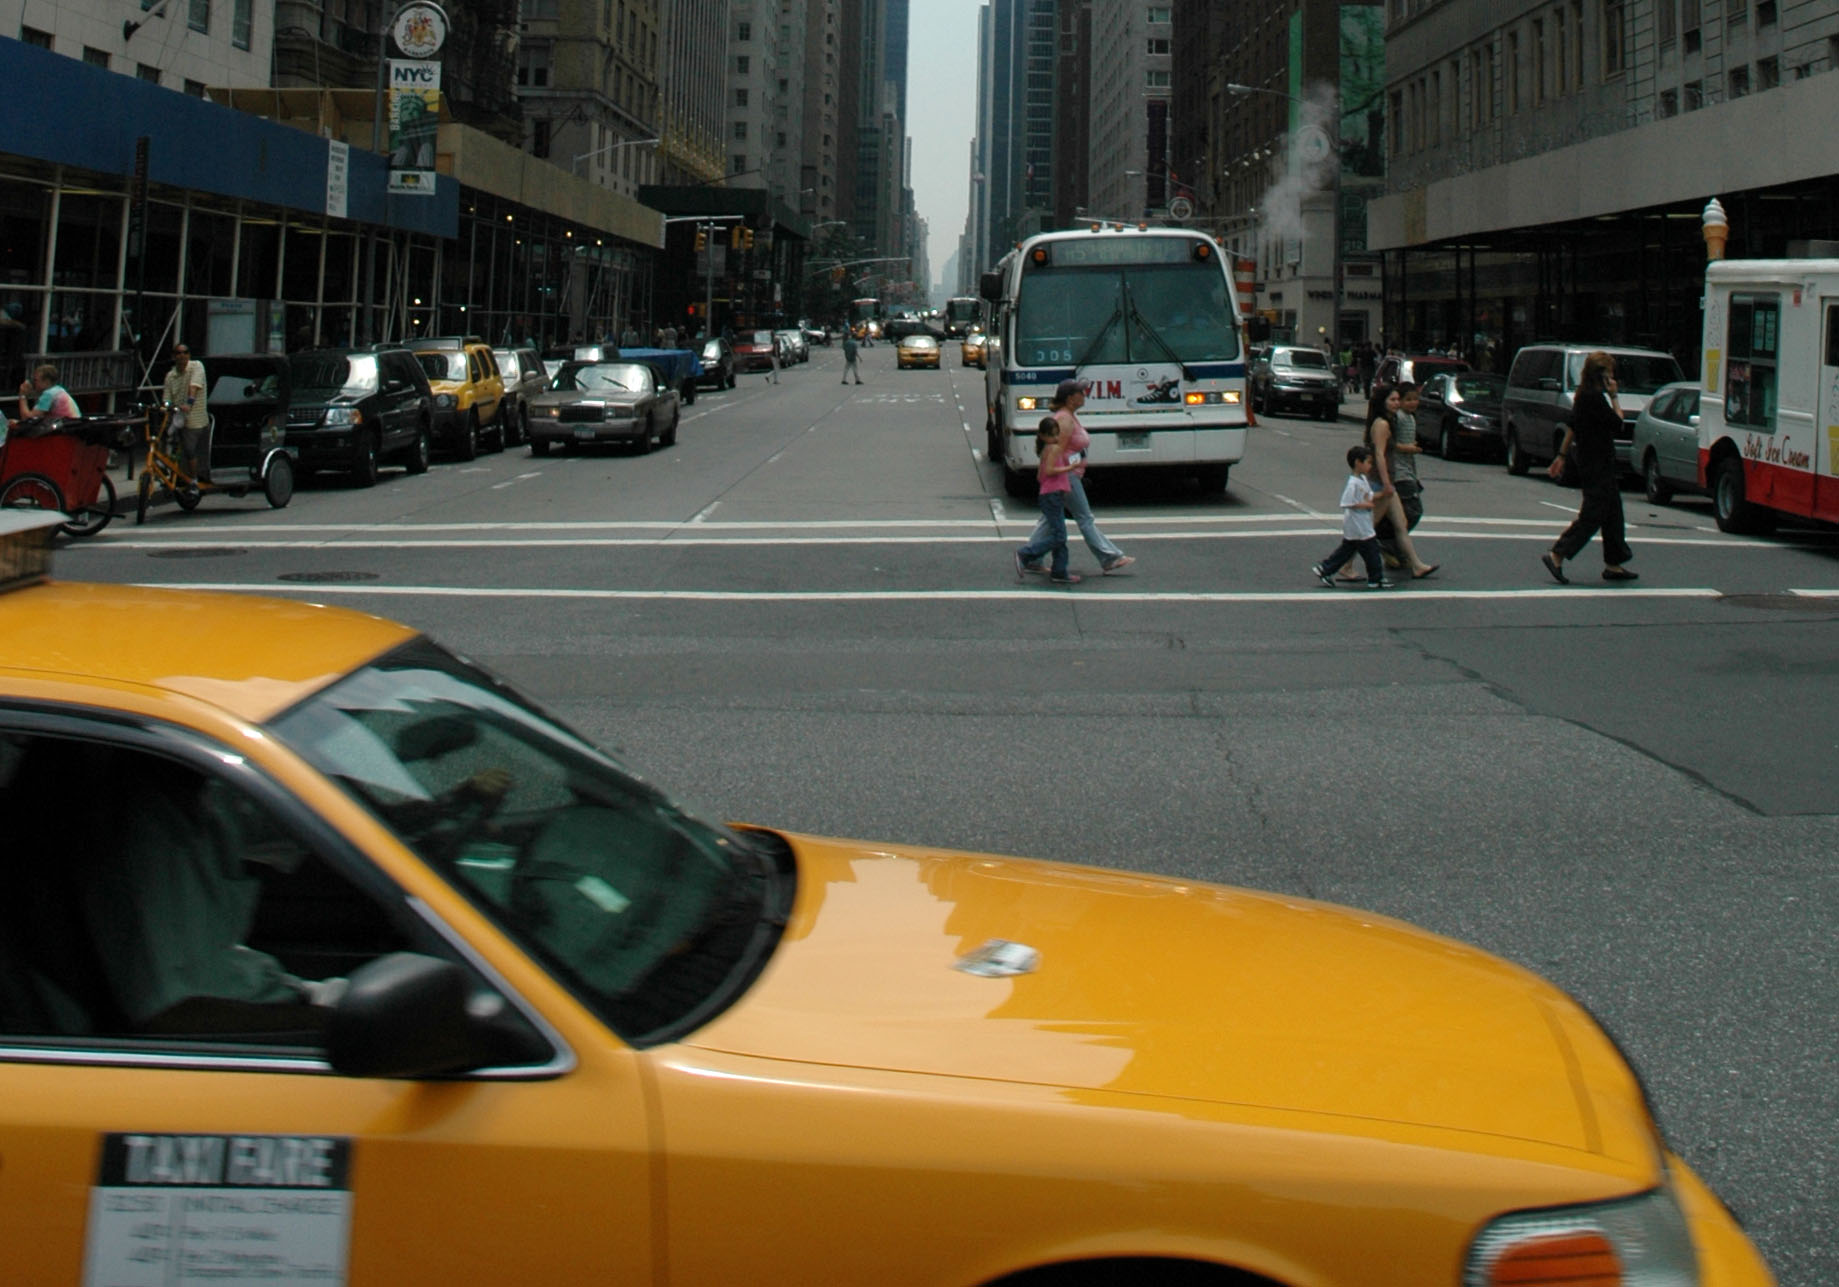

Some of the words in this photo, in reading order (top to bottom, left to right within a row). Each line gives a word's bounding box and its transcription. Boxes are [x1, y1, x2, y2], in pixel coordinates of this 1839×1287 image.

[394, 67, 434, 83] NYC
[1743, 431, 1763, 466] Soft
[1764, 435, 1781, 463] Ice
[1782, 434, 1809, 468] Cream
[124, 1135, 224, 1184] TAXI
[225, 1136, 335, 1186] FARE
